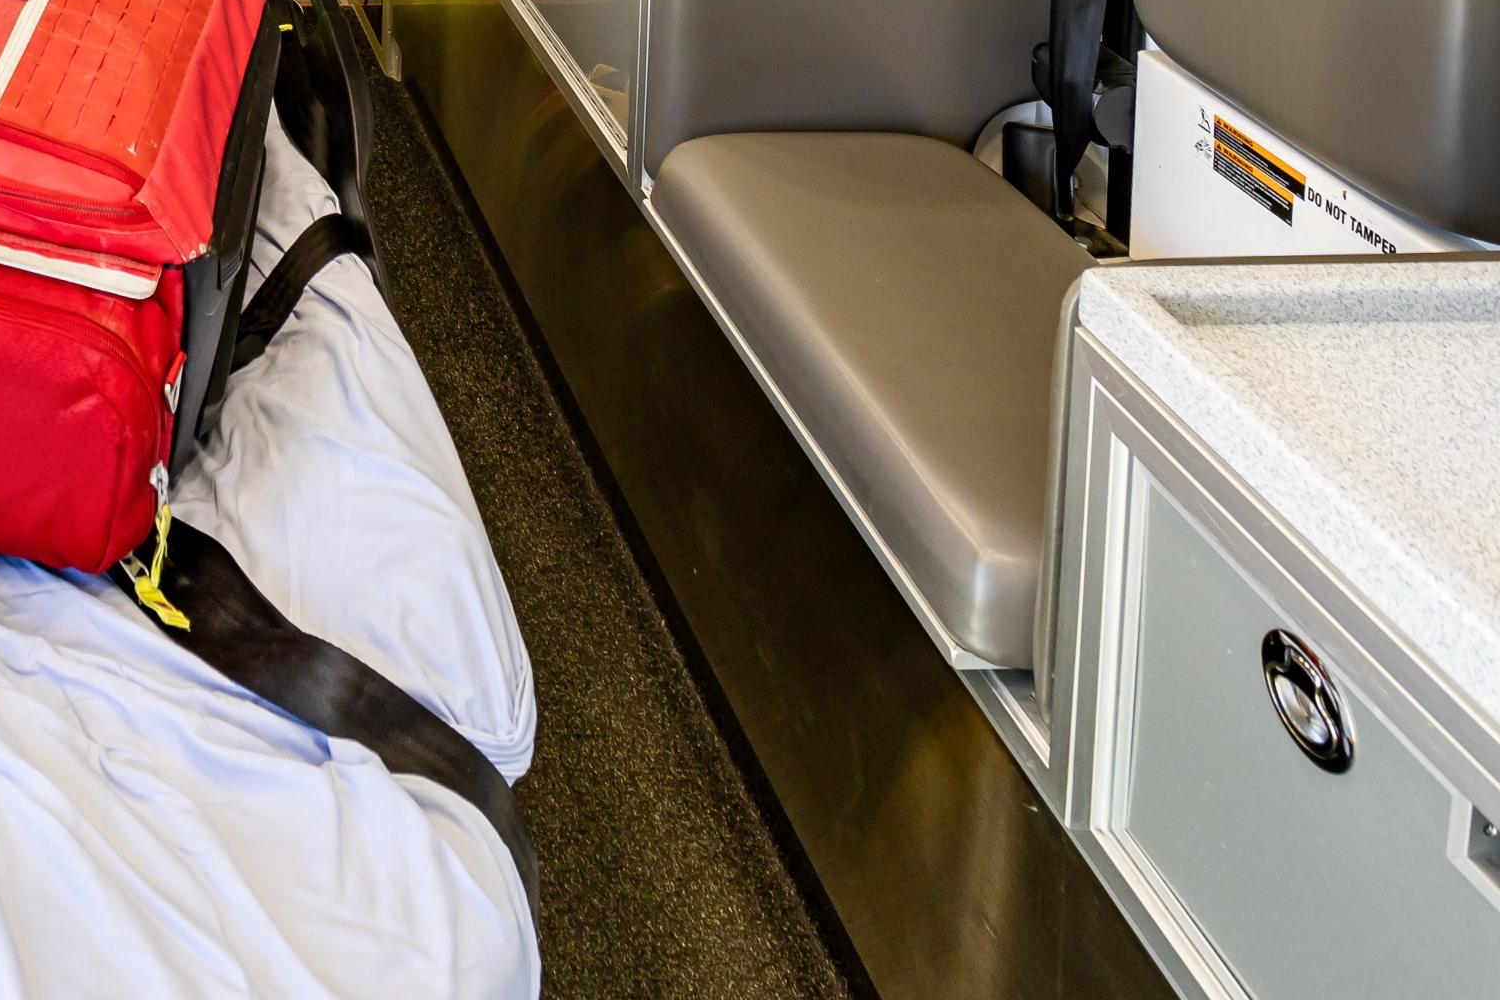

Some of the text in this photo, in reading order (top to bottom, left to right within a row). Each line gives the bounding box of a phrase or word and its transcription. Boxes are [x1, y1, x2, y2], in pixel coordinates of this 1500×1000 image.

[1223, 124, 1254, 147] WARNING
[1223, 148, 1254, 173] WARNING
[1308, 187, 1322, 208] DO
[1325, 199, 1347, 224] NOT
